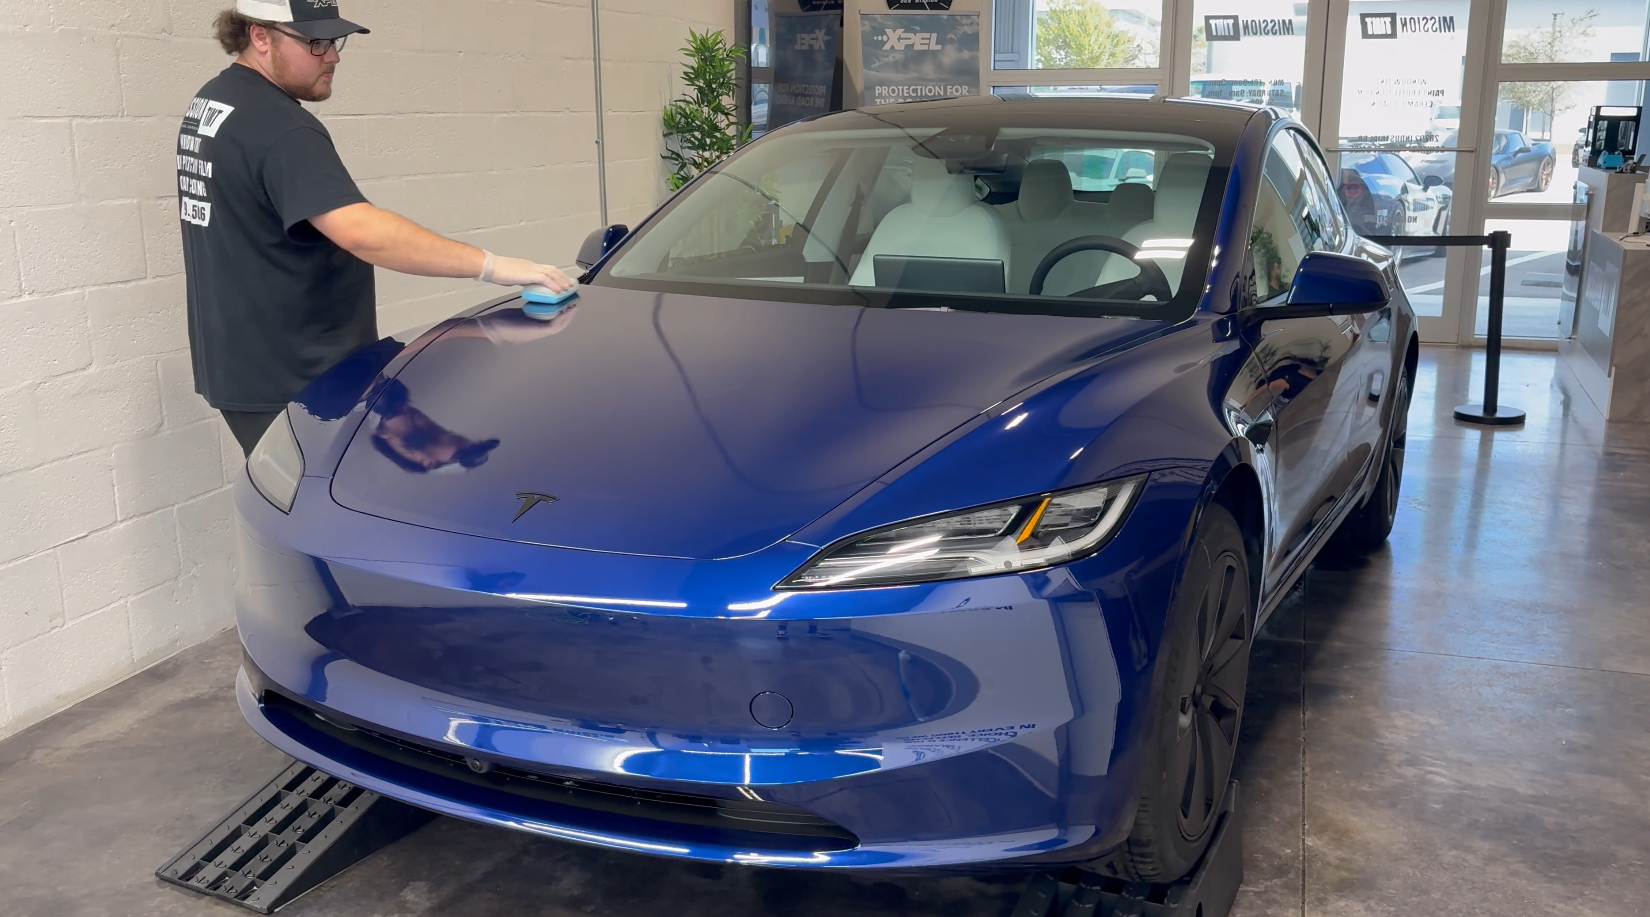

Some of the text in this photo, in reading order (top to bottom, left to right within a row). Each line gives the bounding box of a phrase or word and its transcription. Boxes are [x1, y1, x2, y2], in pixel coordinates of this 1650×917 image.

[881, 28, 942, 50] XPEL
[874, 84, 970, 97] PROTECTION FOR
